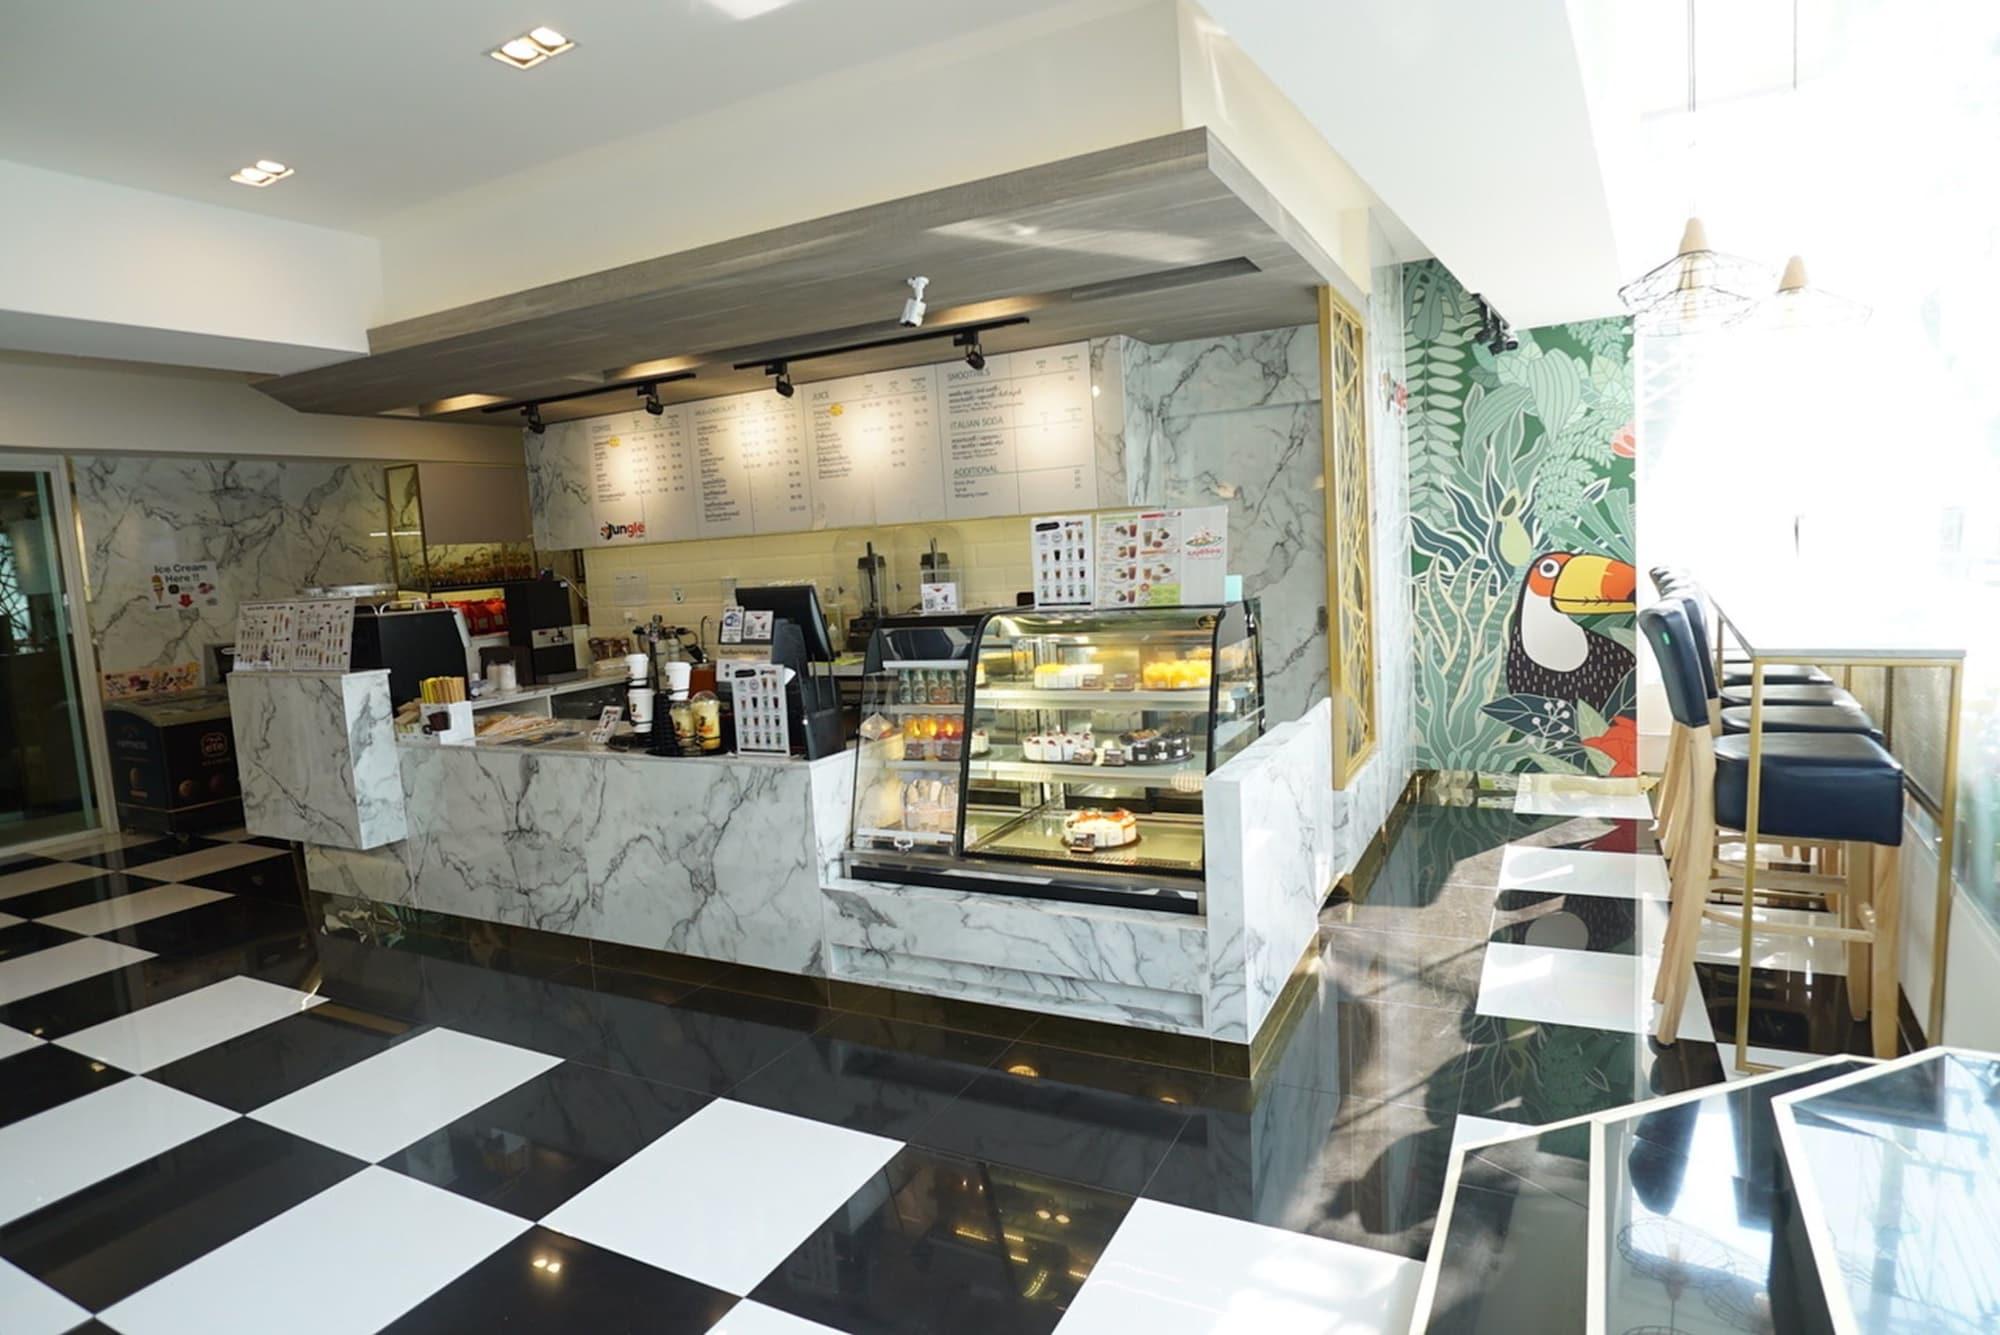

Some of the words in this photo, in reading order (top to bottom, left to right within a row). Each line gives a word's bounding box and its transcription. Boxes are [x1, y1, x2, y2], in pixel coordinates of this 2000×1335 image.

[950, 418, 980, 430] ITALIAN
[982, 416, 1004, 427] SODA
[953, 464, 998, 478] ADDITIONAL
[154, 564, 171, 573] Ice
[172, 563, 208, 573] Cream
[165, 574, 191, 583] Here
